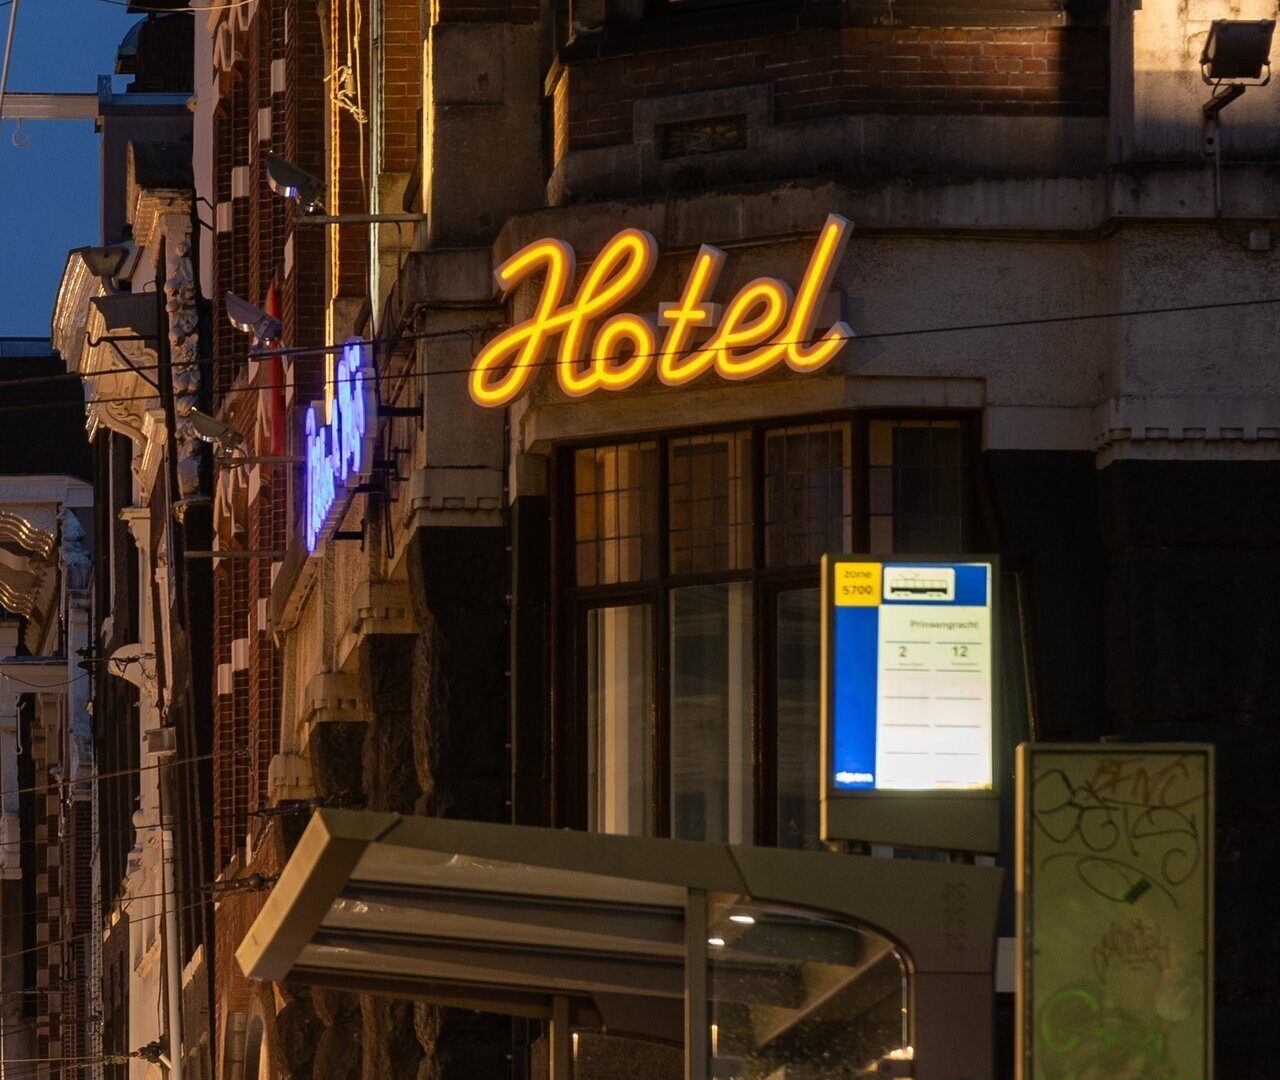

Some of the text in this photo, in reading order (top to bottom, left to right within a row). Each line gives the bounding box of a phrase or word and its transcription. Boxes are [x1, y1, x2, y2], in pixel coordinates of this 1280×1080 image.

[469, 213, 854, 407] Hotel
[843, 569, 872, 579] zone
[842, 584, 874, 596] 5700
[898, 646, 908, 658] 2
[951, 645, 969, 658] 12
